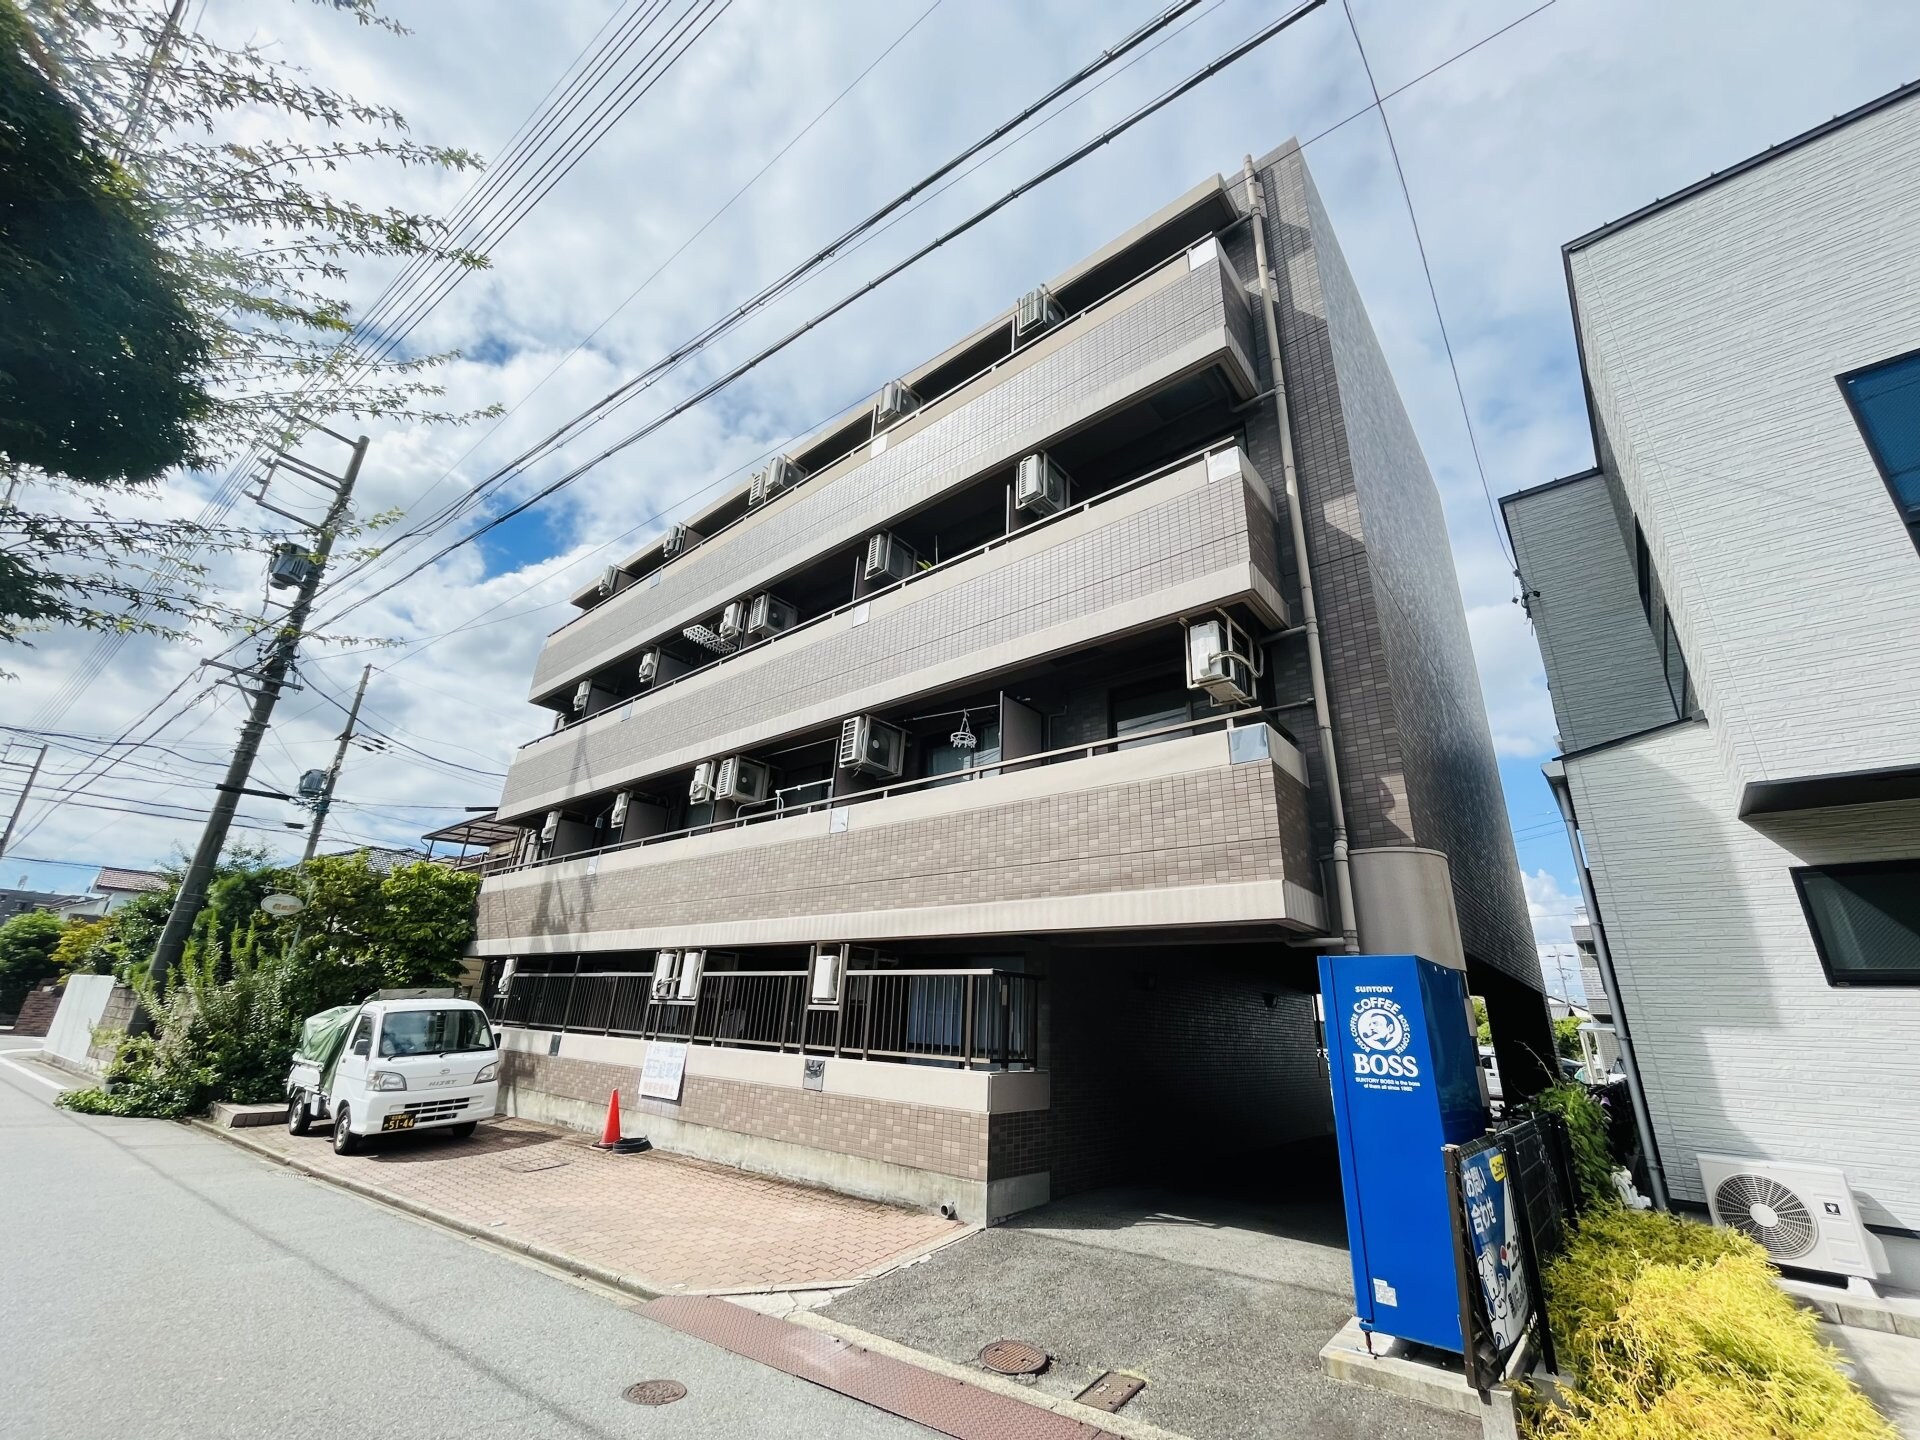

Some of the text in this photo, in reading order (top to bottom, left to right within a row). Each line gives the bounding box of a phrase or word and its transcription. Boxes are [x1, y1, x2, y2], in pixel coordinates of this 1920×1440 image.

[1354, 997, 1401, 1014] COFFEE
[1350, 1013, 1359, 1037] COFFEE
[1352, 1053, 1419, 1077] BOSS
[1471, 1196, 1497, 1235] 合わせ
